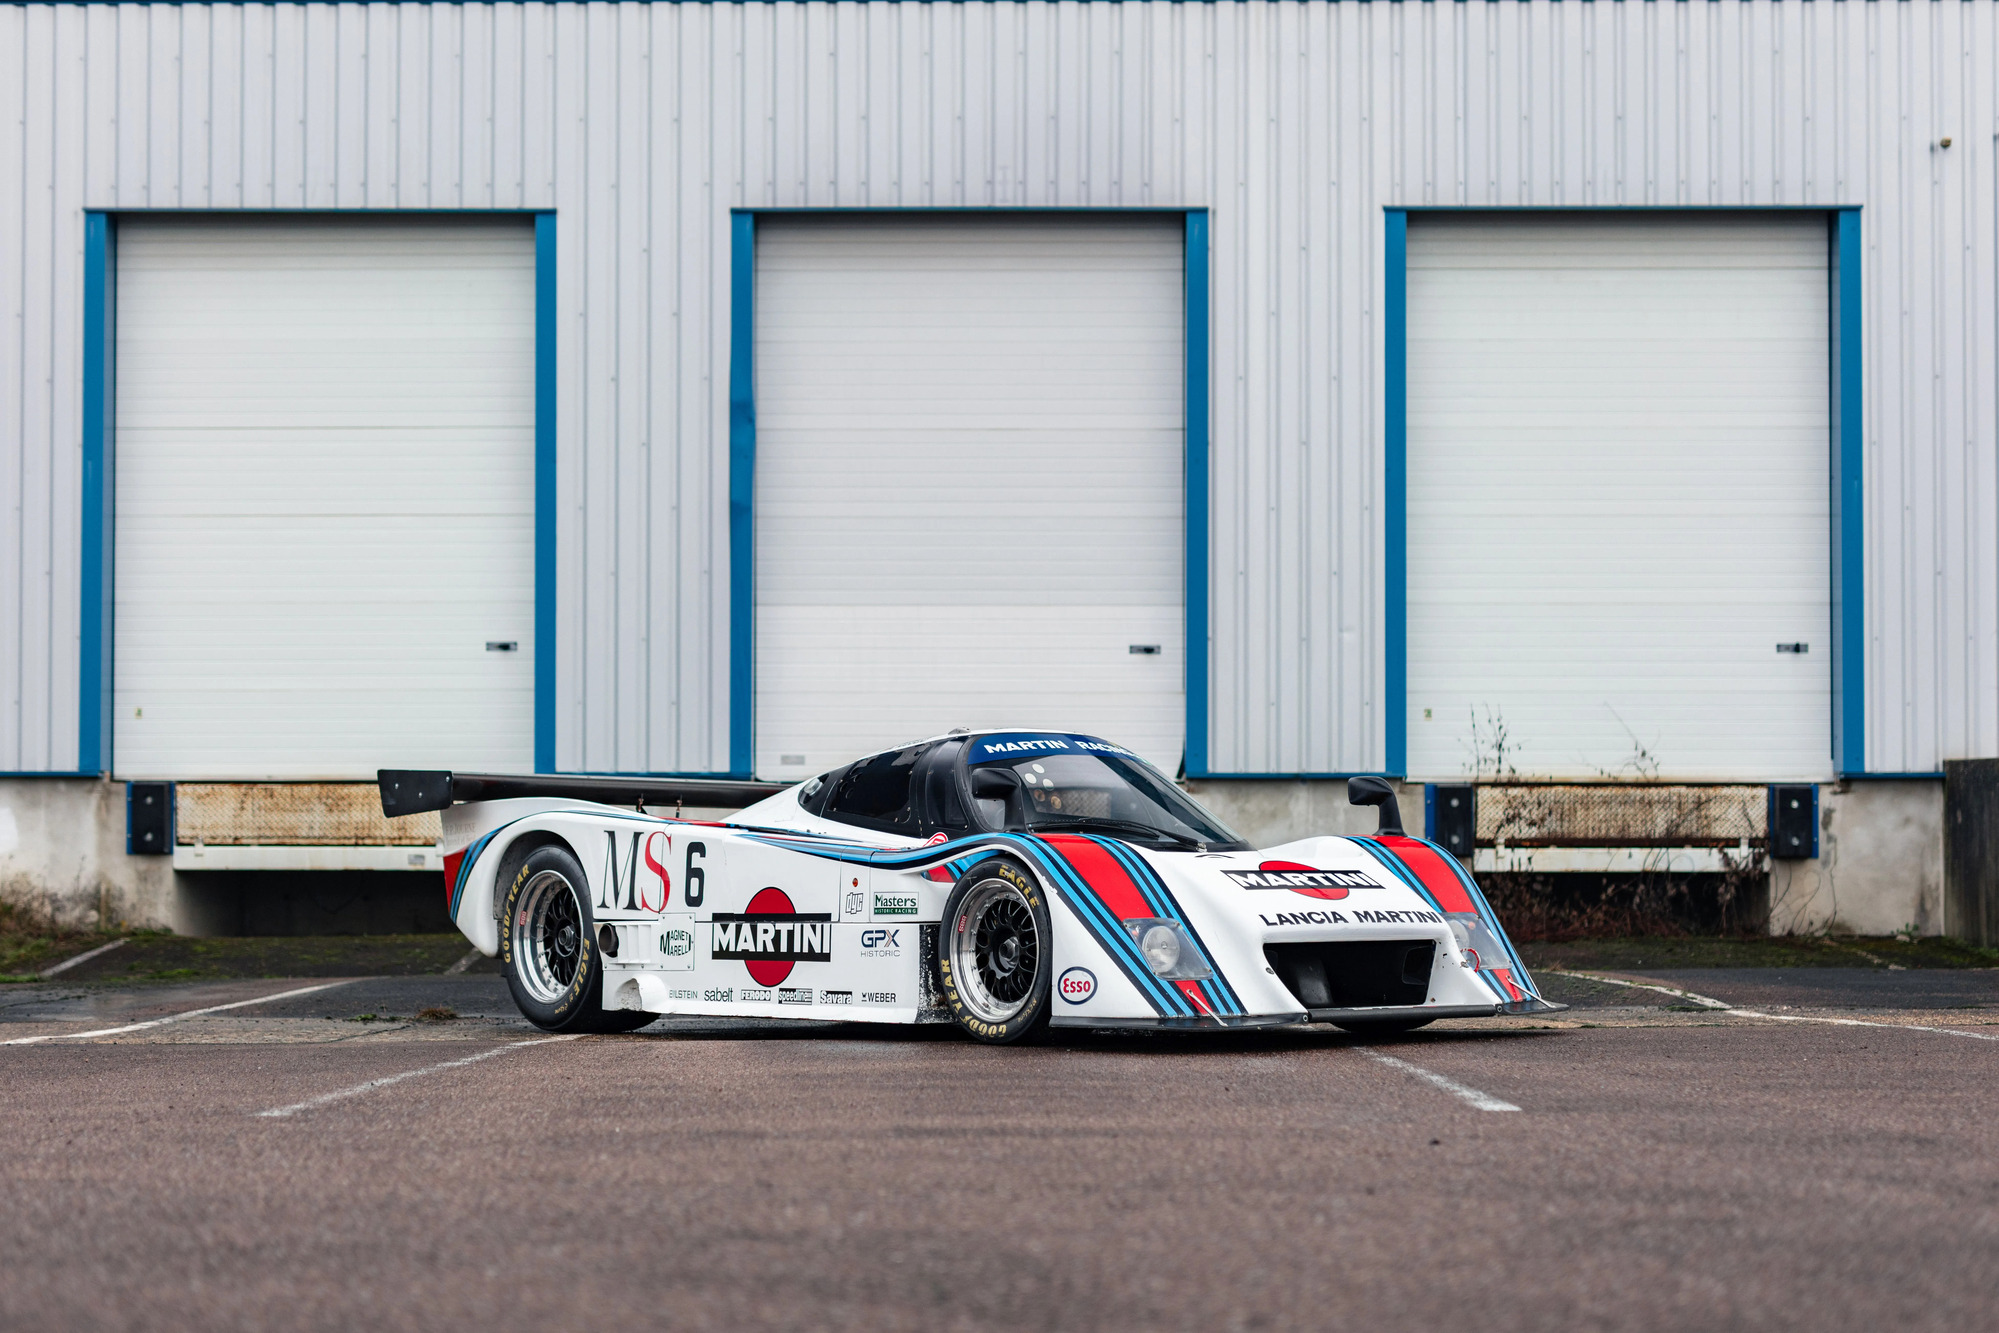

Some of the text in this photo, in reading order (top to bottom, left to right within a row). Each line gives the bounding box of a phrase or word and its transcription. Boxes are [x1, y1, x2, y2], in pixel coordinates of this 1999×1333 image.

[984, 739, 1069, 753] MARTIN
[597, 830, 672, 913] MS
[685, 841, 706, 907] 6
[999, 864, 1039, 909] EAGLE
[1227, 873, 1382, 887] MARTINI
[875, 895, 917, 907] Masters
[503, 864, 530, 964] GOODYEAR
[1258, 910, 1443, 926] LANCIA MARTINI
[713, 922, 830, 953] MARTINI
[861, 929, 900, 948] GPX
[861, 950, 900, 958] HISTORIC
[574, 937, 591, 996] EAGLE
[704, 987, 733, 1002] sabelt
[742, 990, 771, 1001] FERODO
[820, 990, 852, 1004] Savara
[868, 992, 897, 1003] WEBER
[941, 959, 1007, 1037] GOODYEAR
